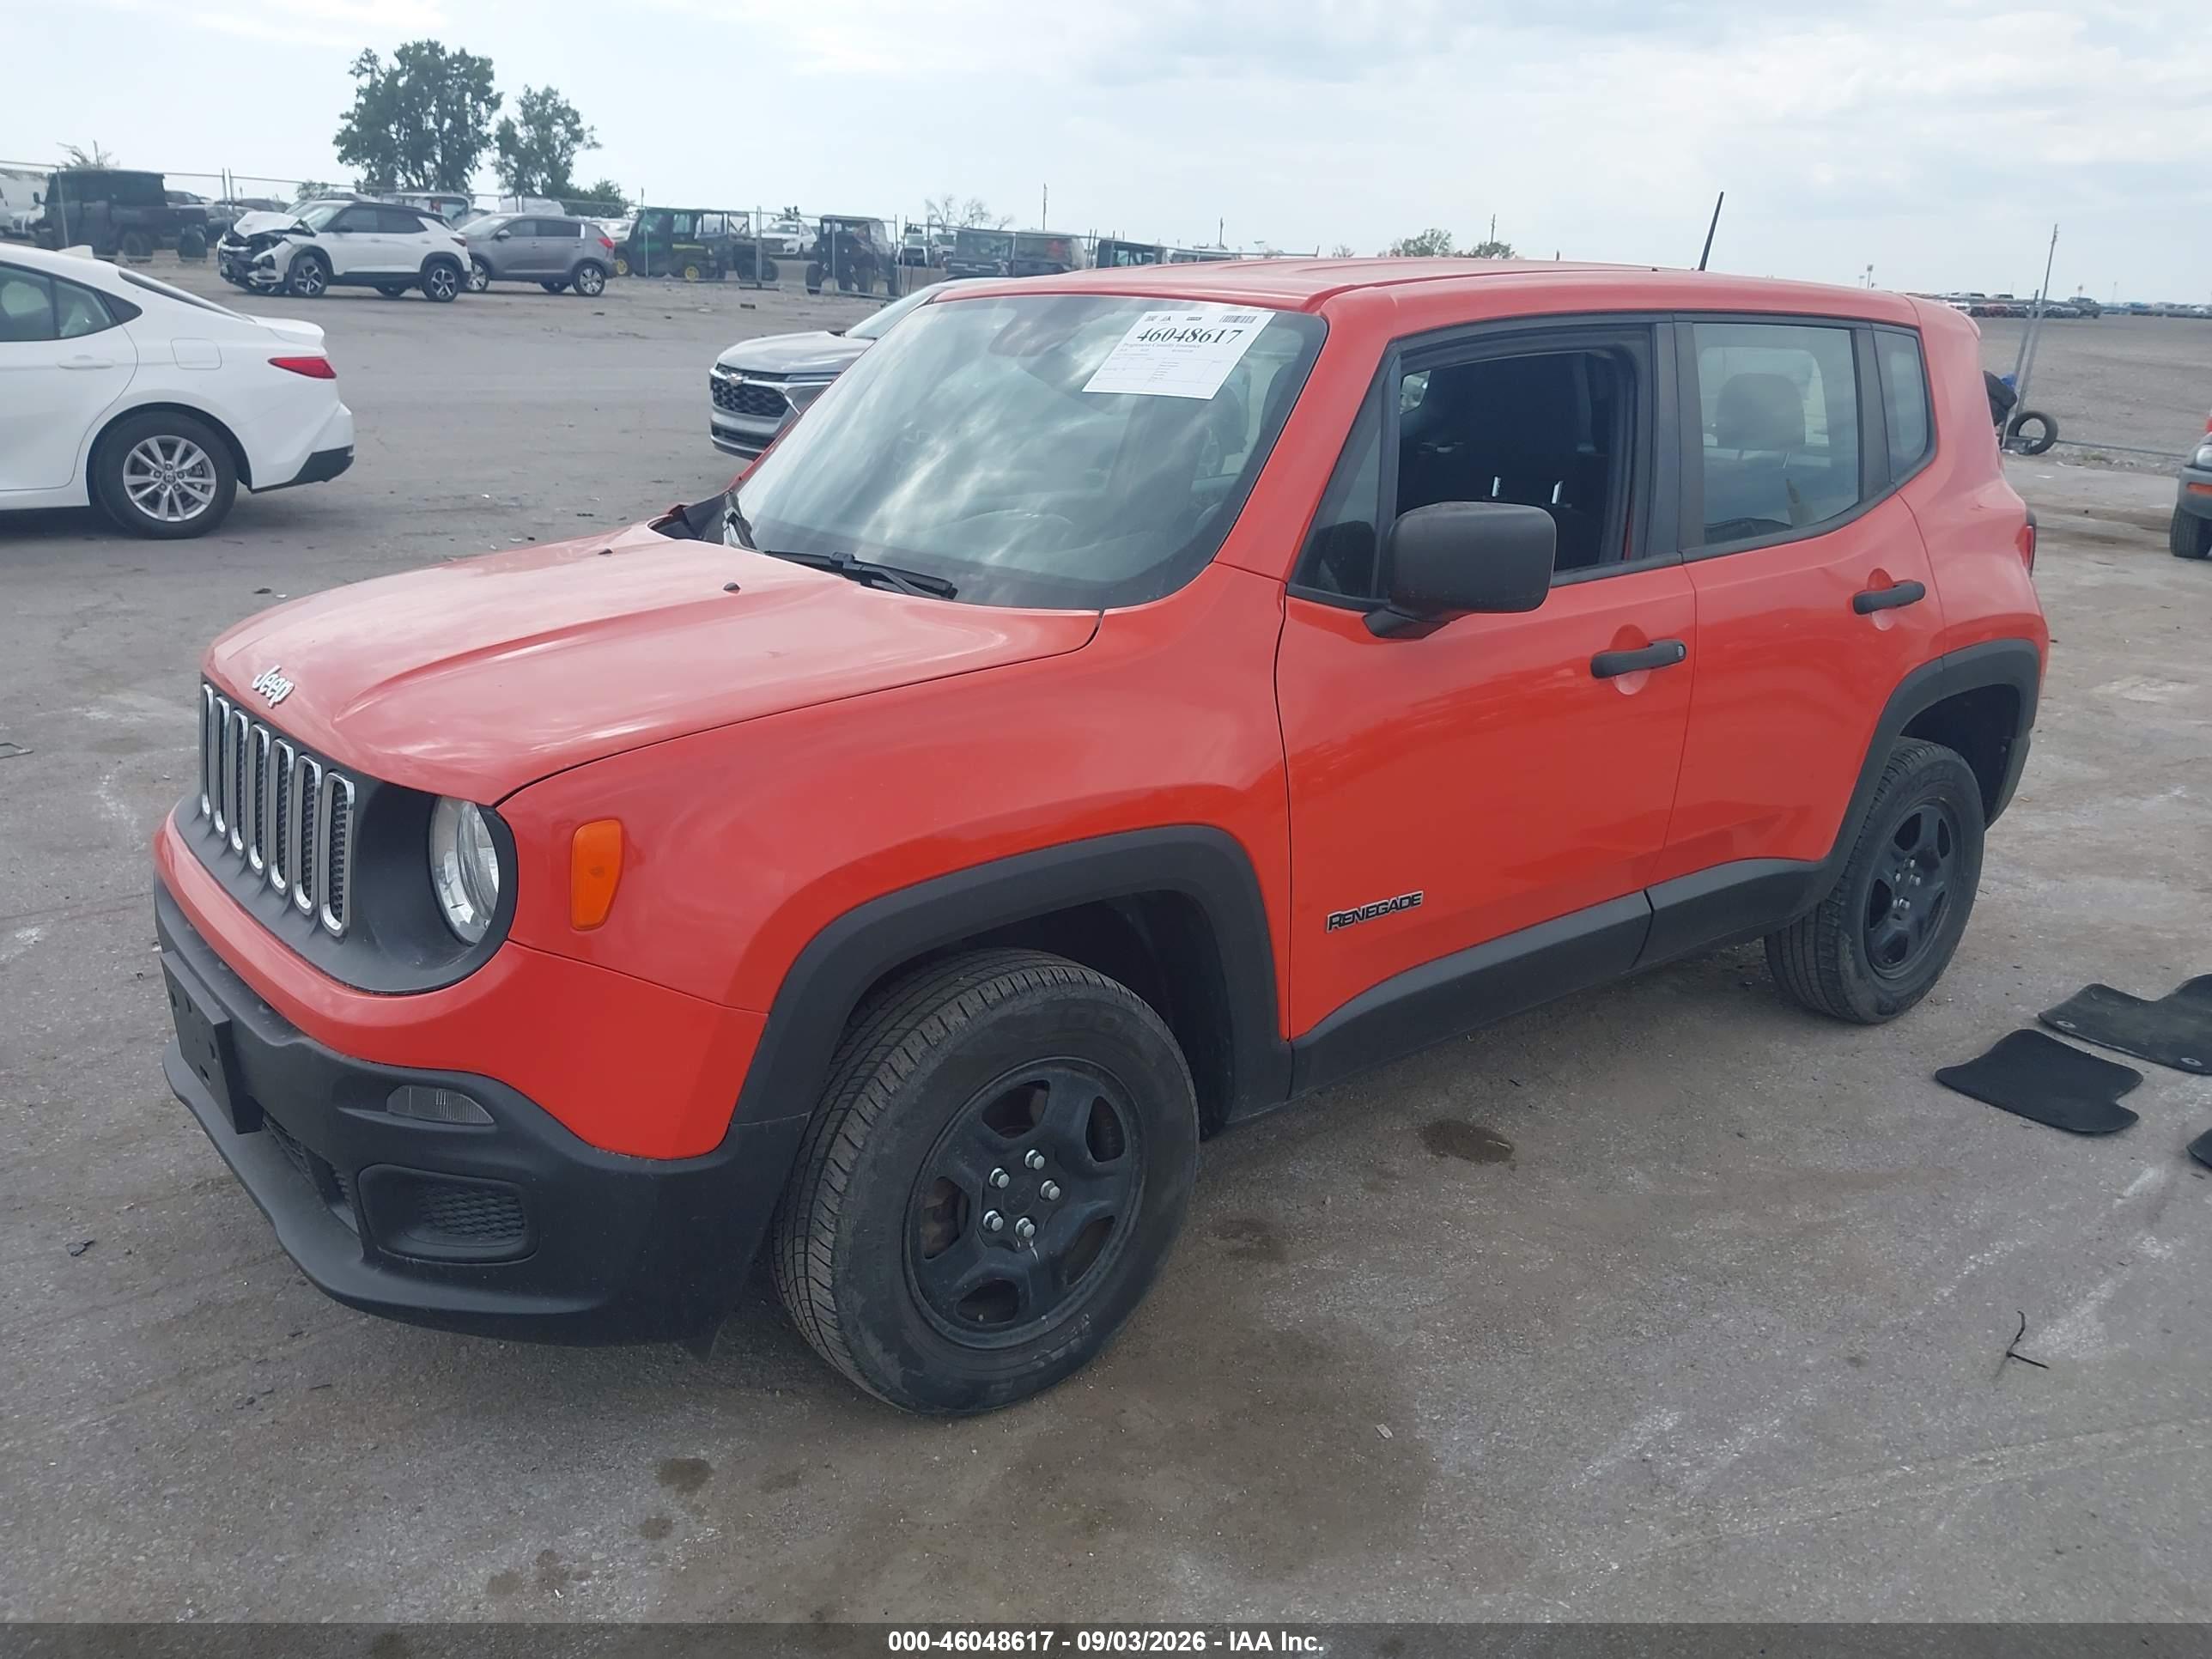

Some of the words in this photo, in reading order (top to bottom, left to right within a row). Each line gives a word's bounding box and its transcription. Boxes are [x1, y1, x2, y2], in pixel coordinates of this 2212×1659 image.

[1137, 327, 1243, 343] 46048617
[252, 665, 295, 708] Jeep
[1327, 890, 1423, 933] RENEGADE
